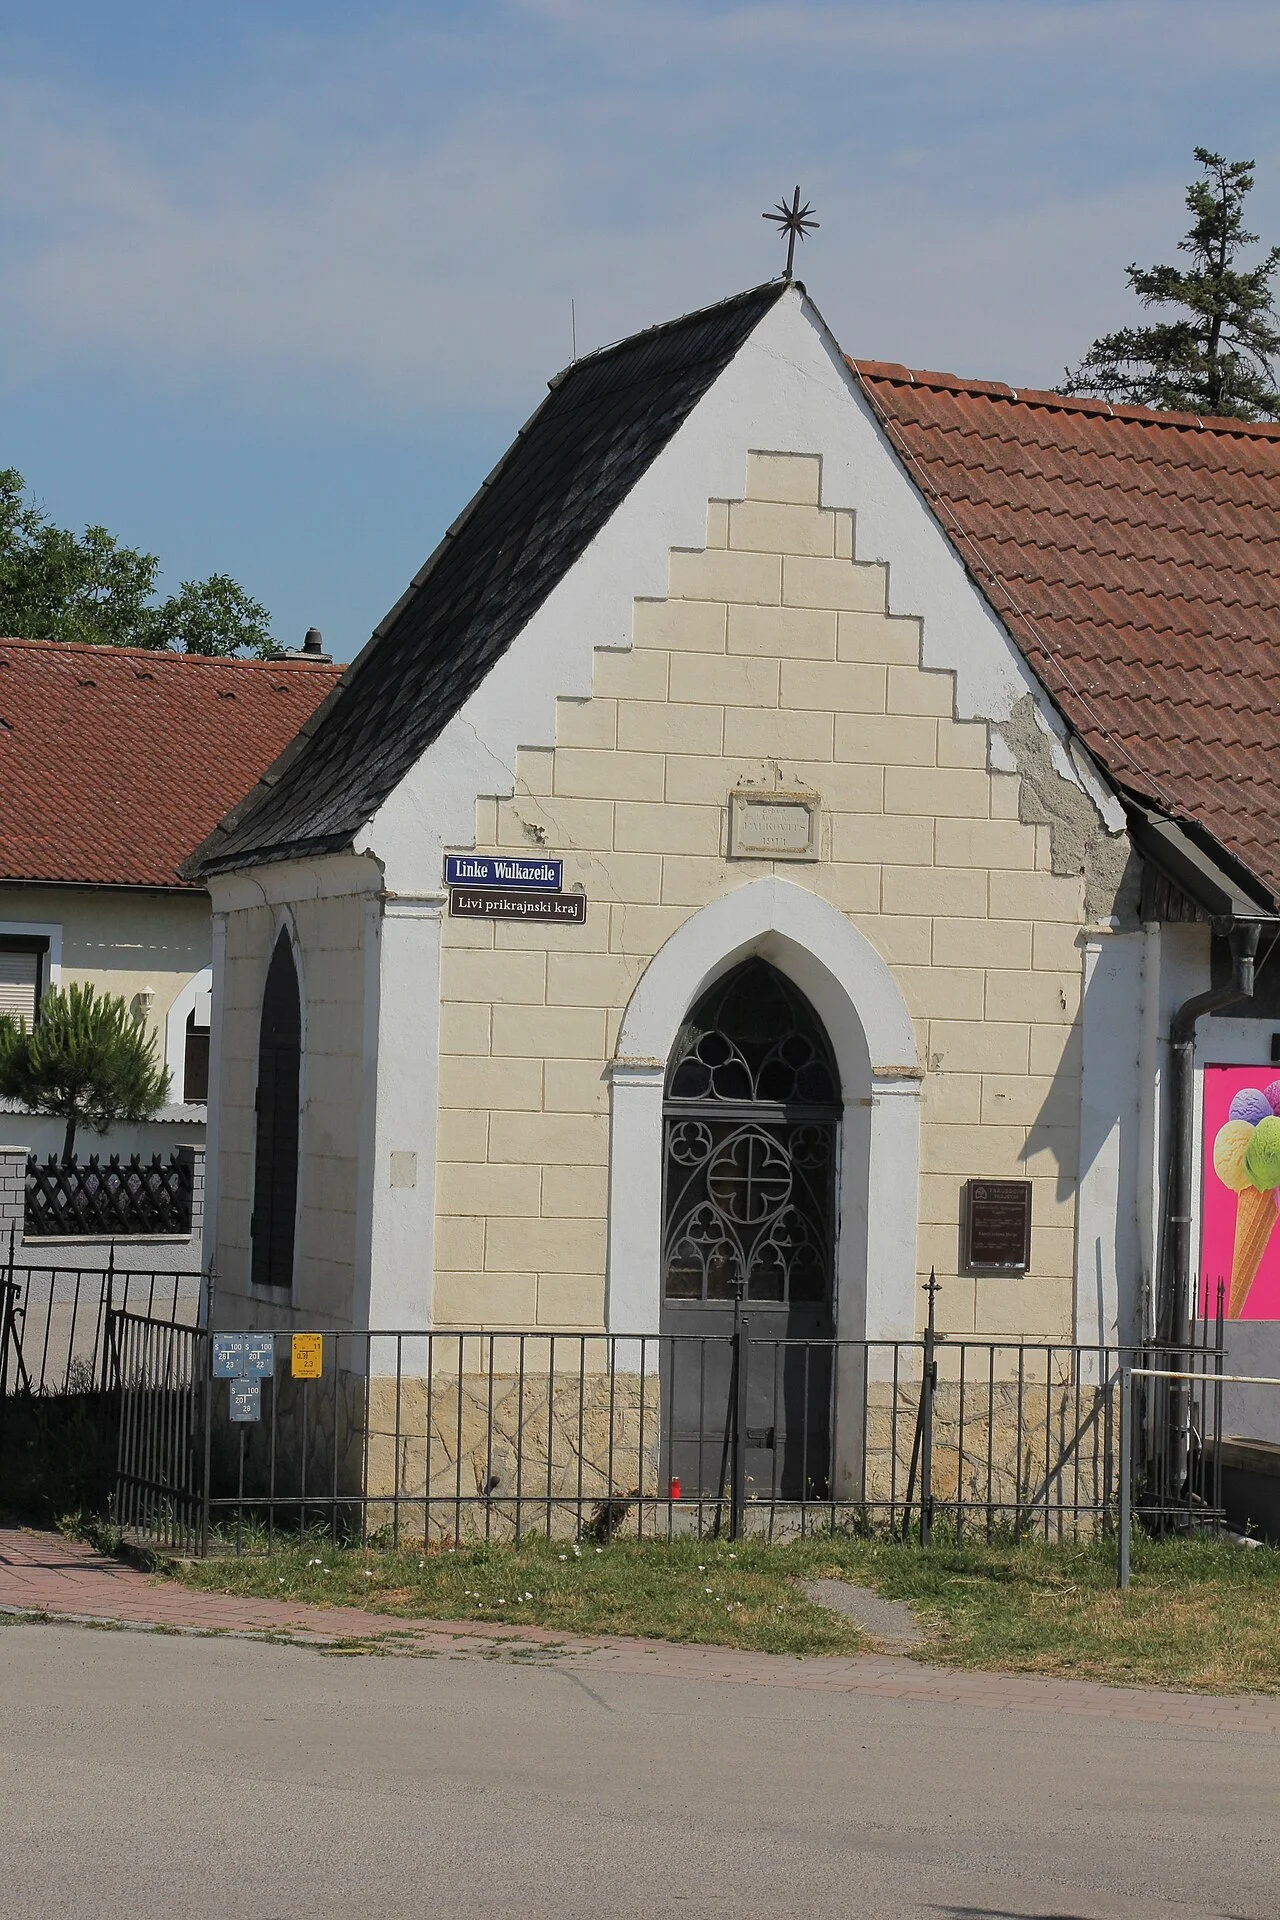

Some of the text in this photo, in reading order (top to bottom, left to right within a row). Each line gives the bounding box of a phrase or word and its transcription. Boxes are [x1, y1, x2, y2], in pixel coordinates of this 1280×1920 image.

[455, 861, 555, 881] Linke Wulkazeile
[458, 897, 578, 917] Livi prikrajnski kraj
